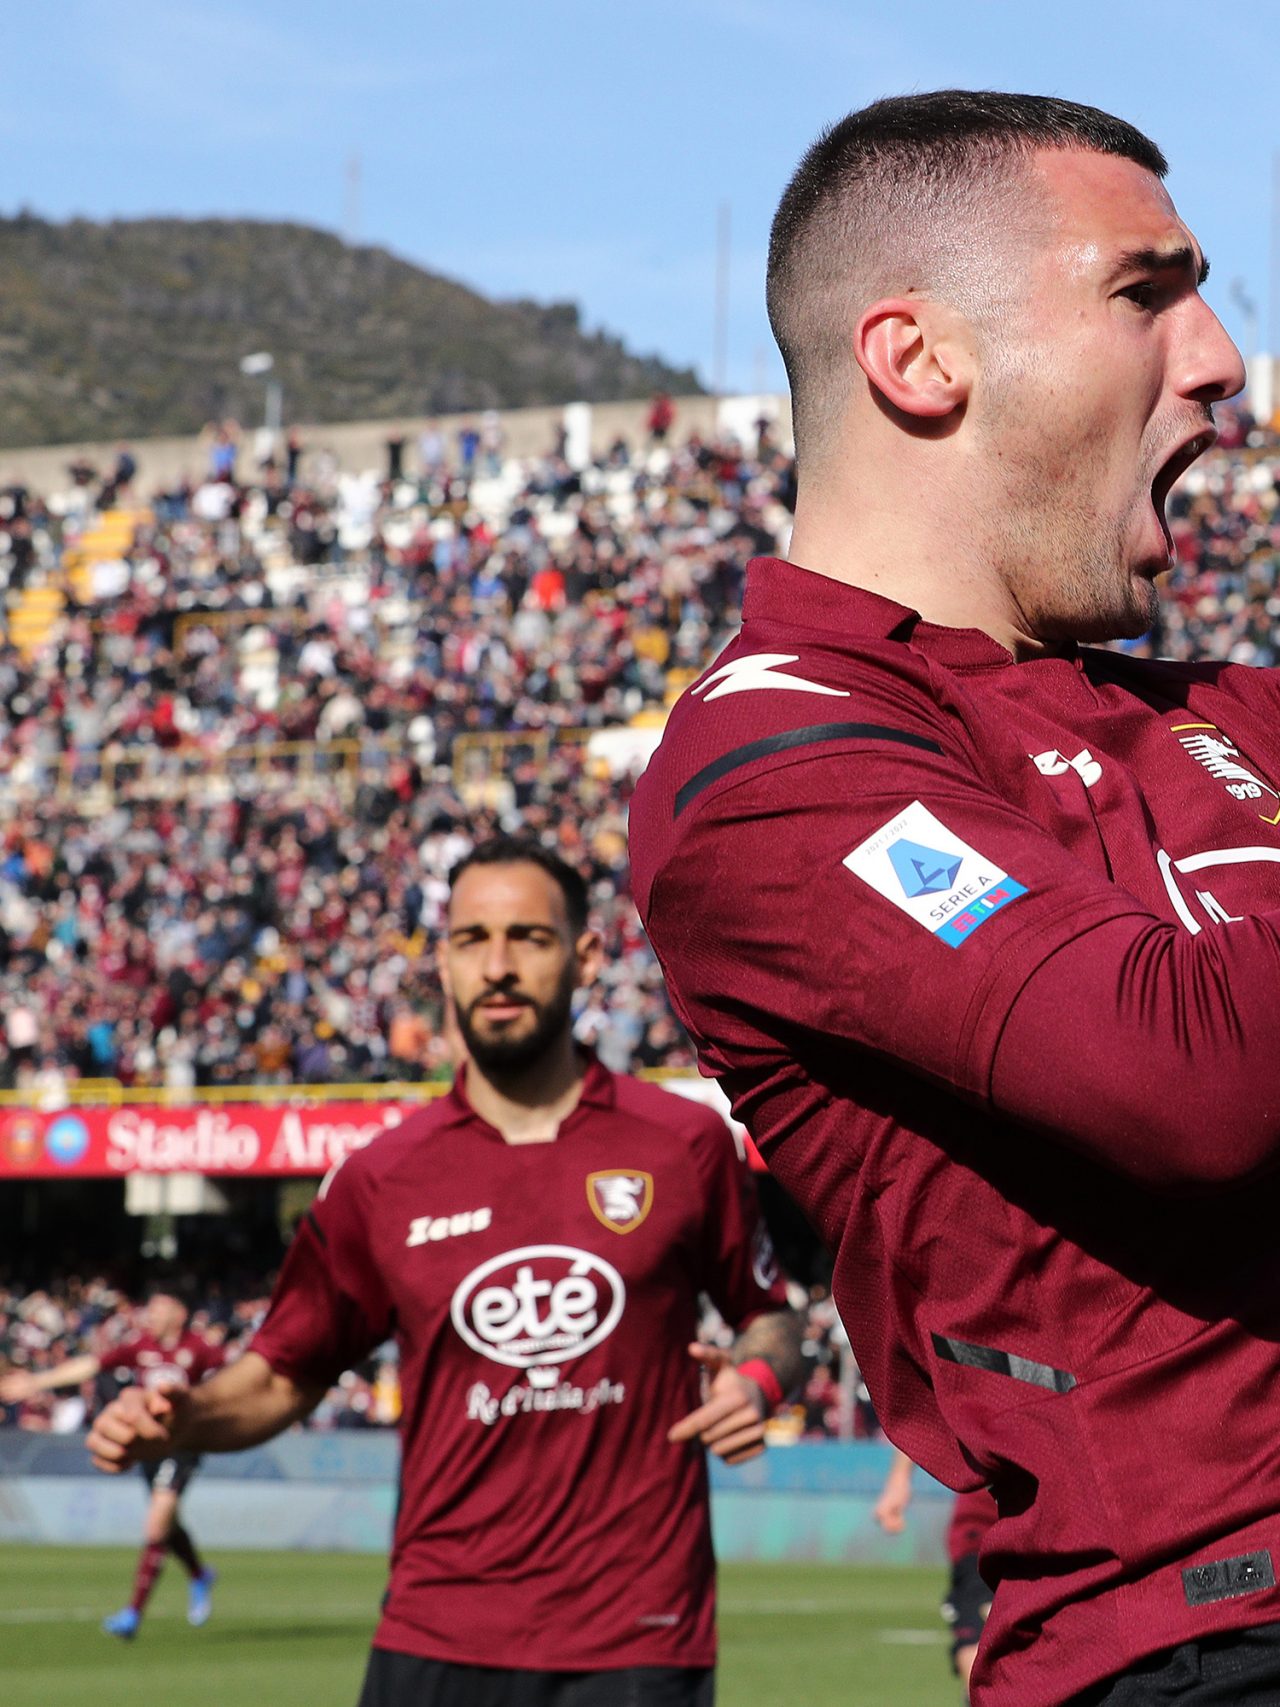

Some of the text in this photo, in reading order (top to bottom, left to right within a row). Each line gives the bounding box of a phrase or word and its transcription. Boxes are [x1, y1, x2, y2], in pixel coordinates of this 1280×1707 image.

[1225, 782, 1262, 800] 1919
[929, 875, 993, 921] SERIE A
[970, 888, 1010, 914] TIM
[105, 1109, 261, 1171] Stadio
[406, 1206, 493, 1247] Zeus
[471, 1260, 598, 1344] eté
